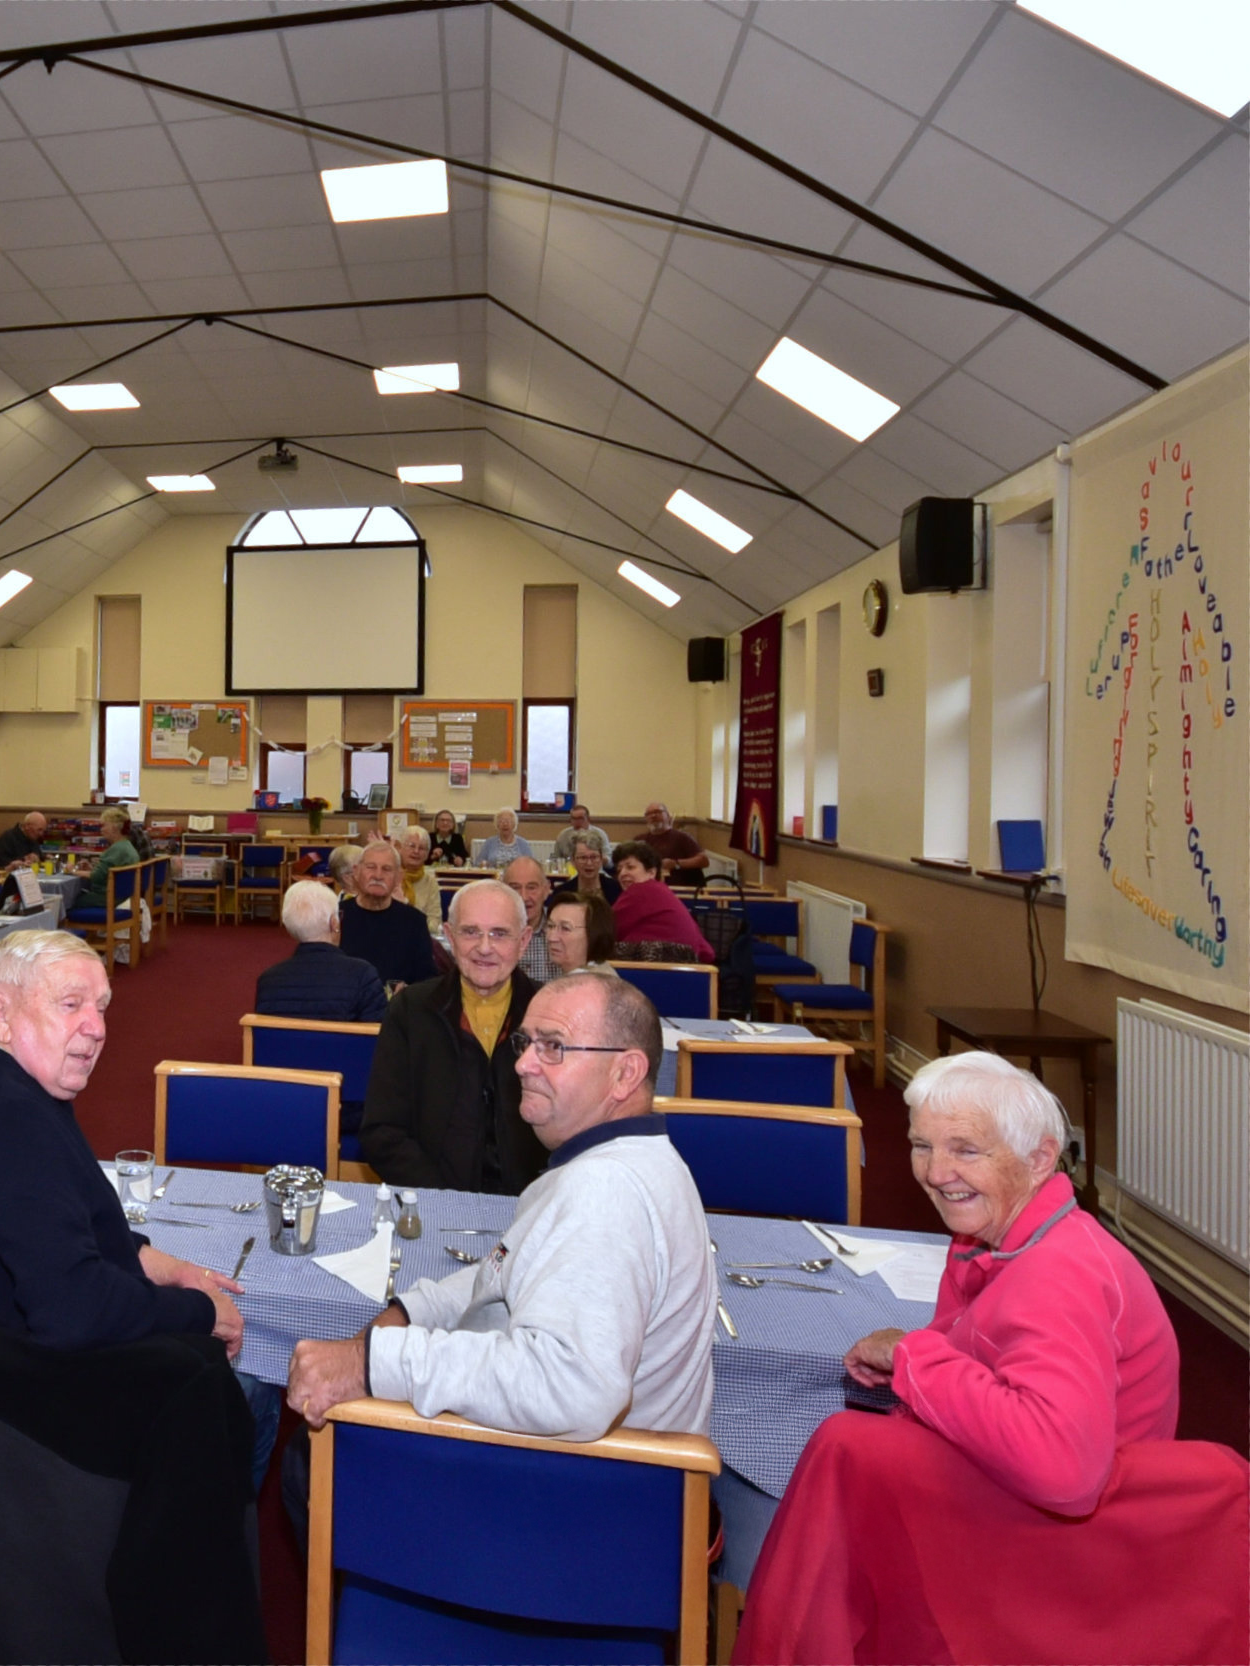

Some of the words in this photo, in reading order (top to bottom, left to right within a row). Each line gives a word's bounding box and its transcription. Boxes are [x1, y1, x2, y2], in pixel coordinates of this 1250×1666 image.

[1139, 441, 1194, 531] Saviour
[1140, 511, 1192, 580] Father
[1095, 631, 1129, 700] Pure
[1150, 588, 1164, 702] HOLY
[1187, 529, 1236, 718] Loveable
[1113, 613, 1139, 777] Forgiving
[1179, 610, 1194, 825] Almighty
[1192, 627, 1223, 729] Holy
[1144, 711, 1159, 878] SPIRIT
[1111, 866, 1175, 932] Lifesaver
[1187, 826, 1227, 943] Caring
[1174, 915, 1225, 969] Worthy
